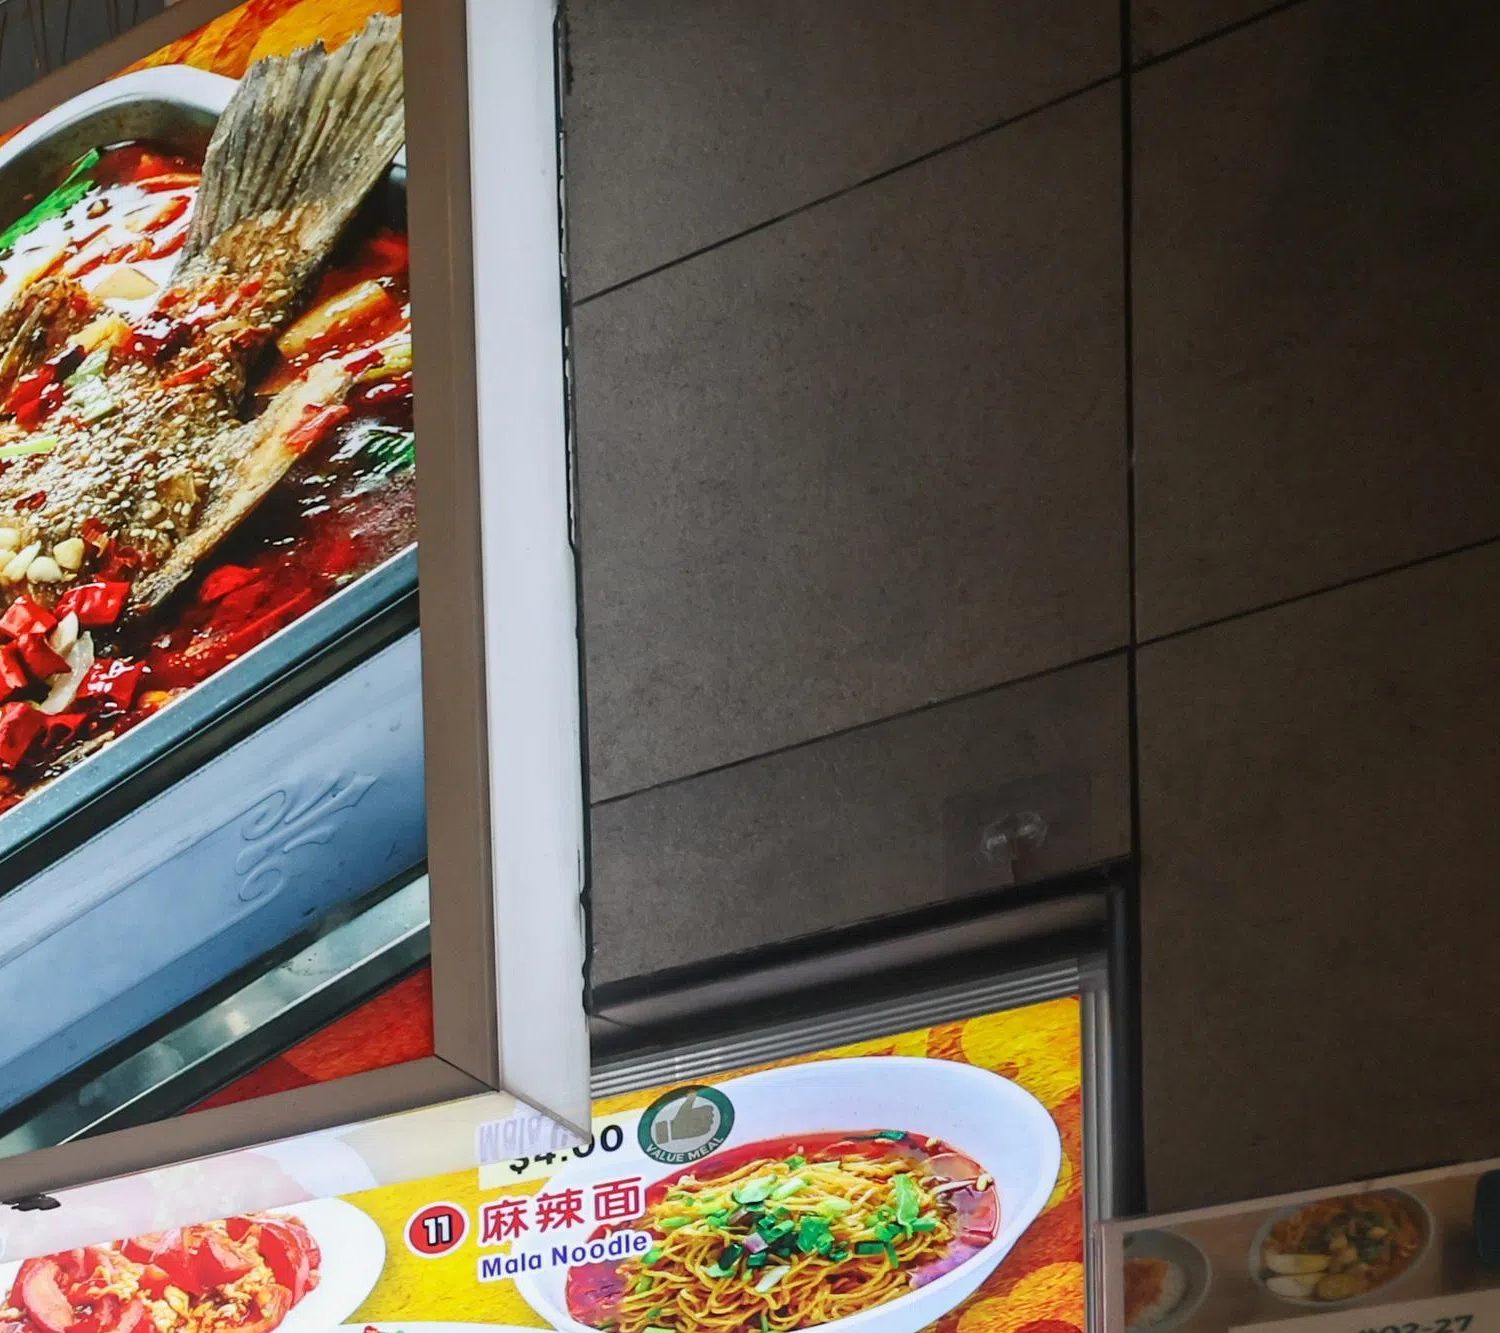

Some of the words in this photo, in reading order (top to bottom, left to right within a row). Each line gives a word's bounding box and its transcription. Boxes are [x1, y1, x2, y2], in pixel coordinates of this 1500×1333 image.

[644, 1142, 685, 1164] VALUE
[687, 1135, 726, 1162] MEAL
[420, 1212, 455, 1247] 11
[481, 1175, 644, 1244] 麻辣面
[481, 1251, 543, 1280] Mala
[550, 1233, 649, 1267] Noodle
